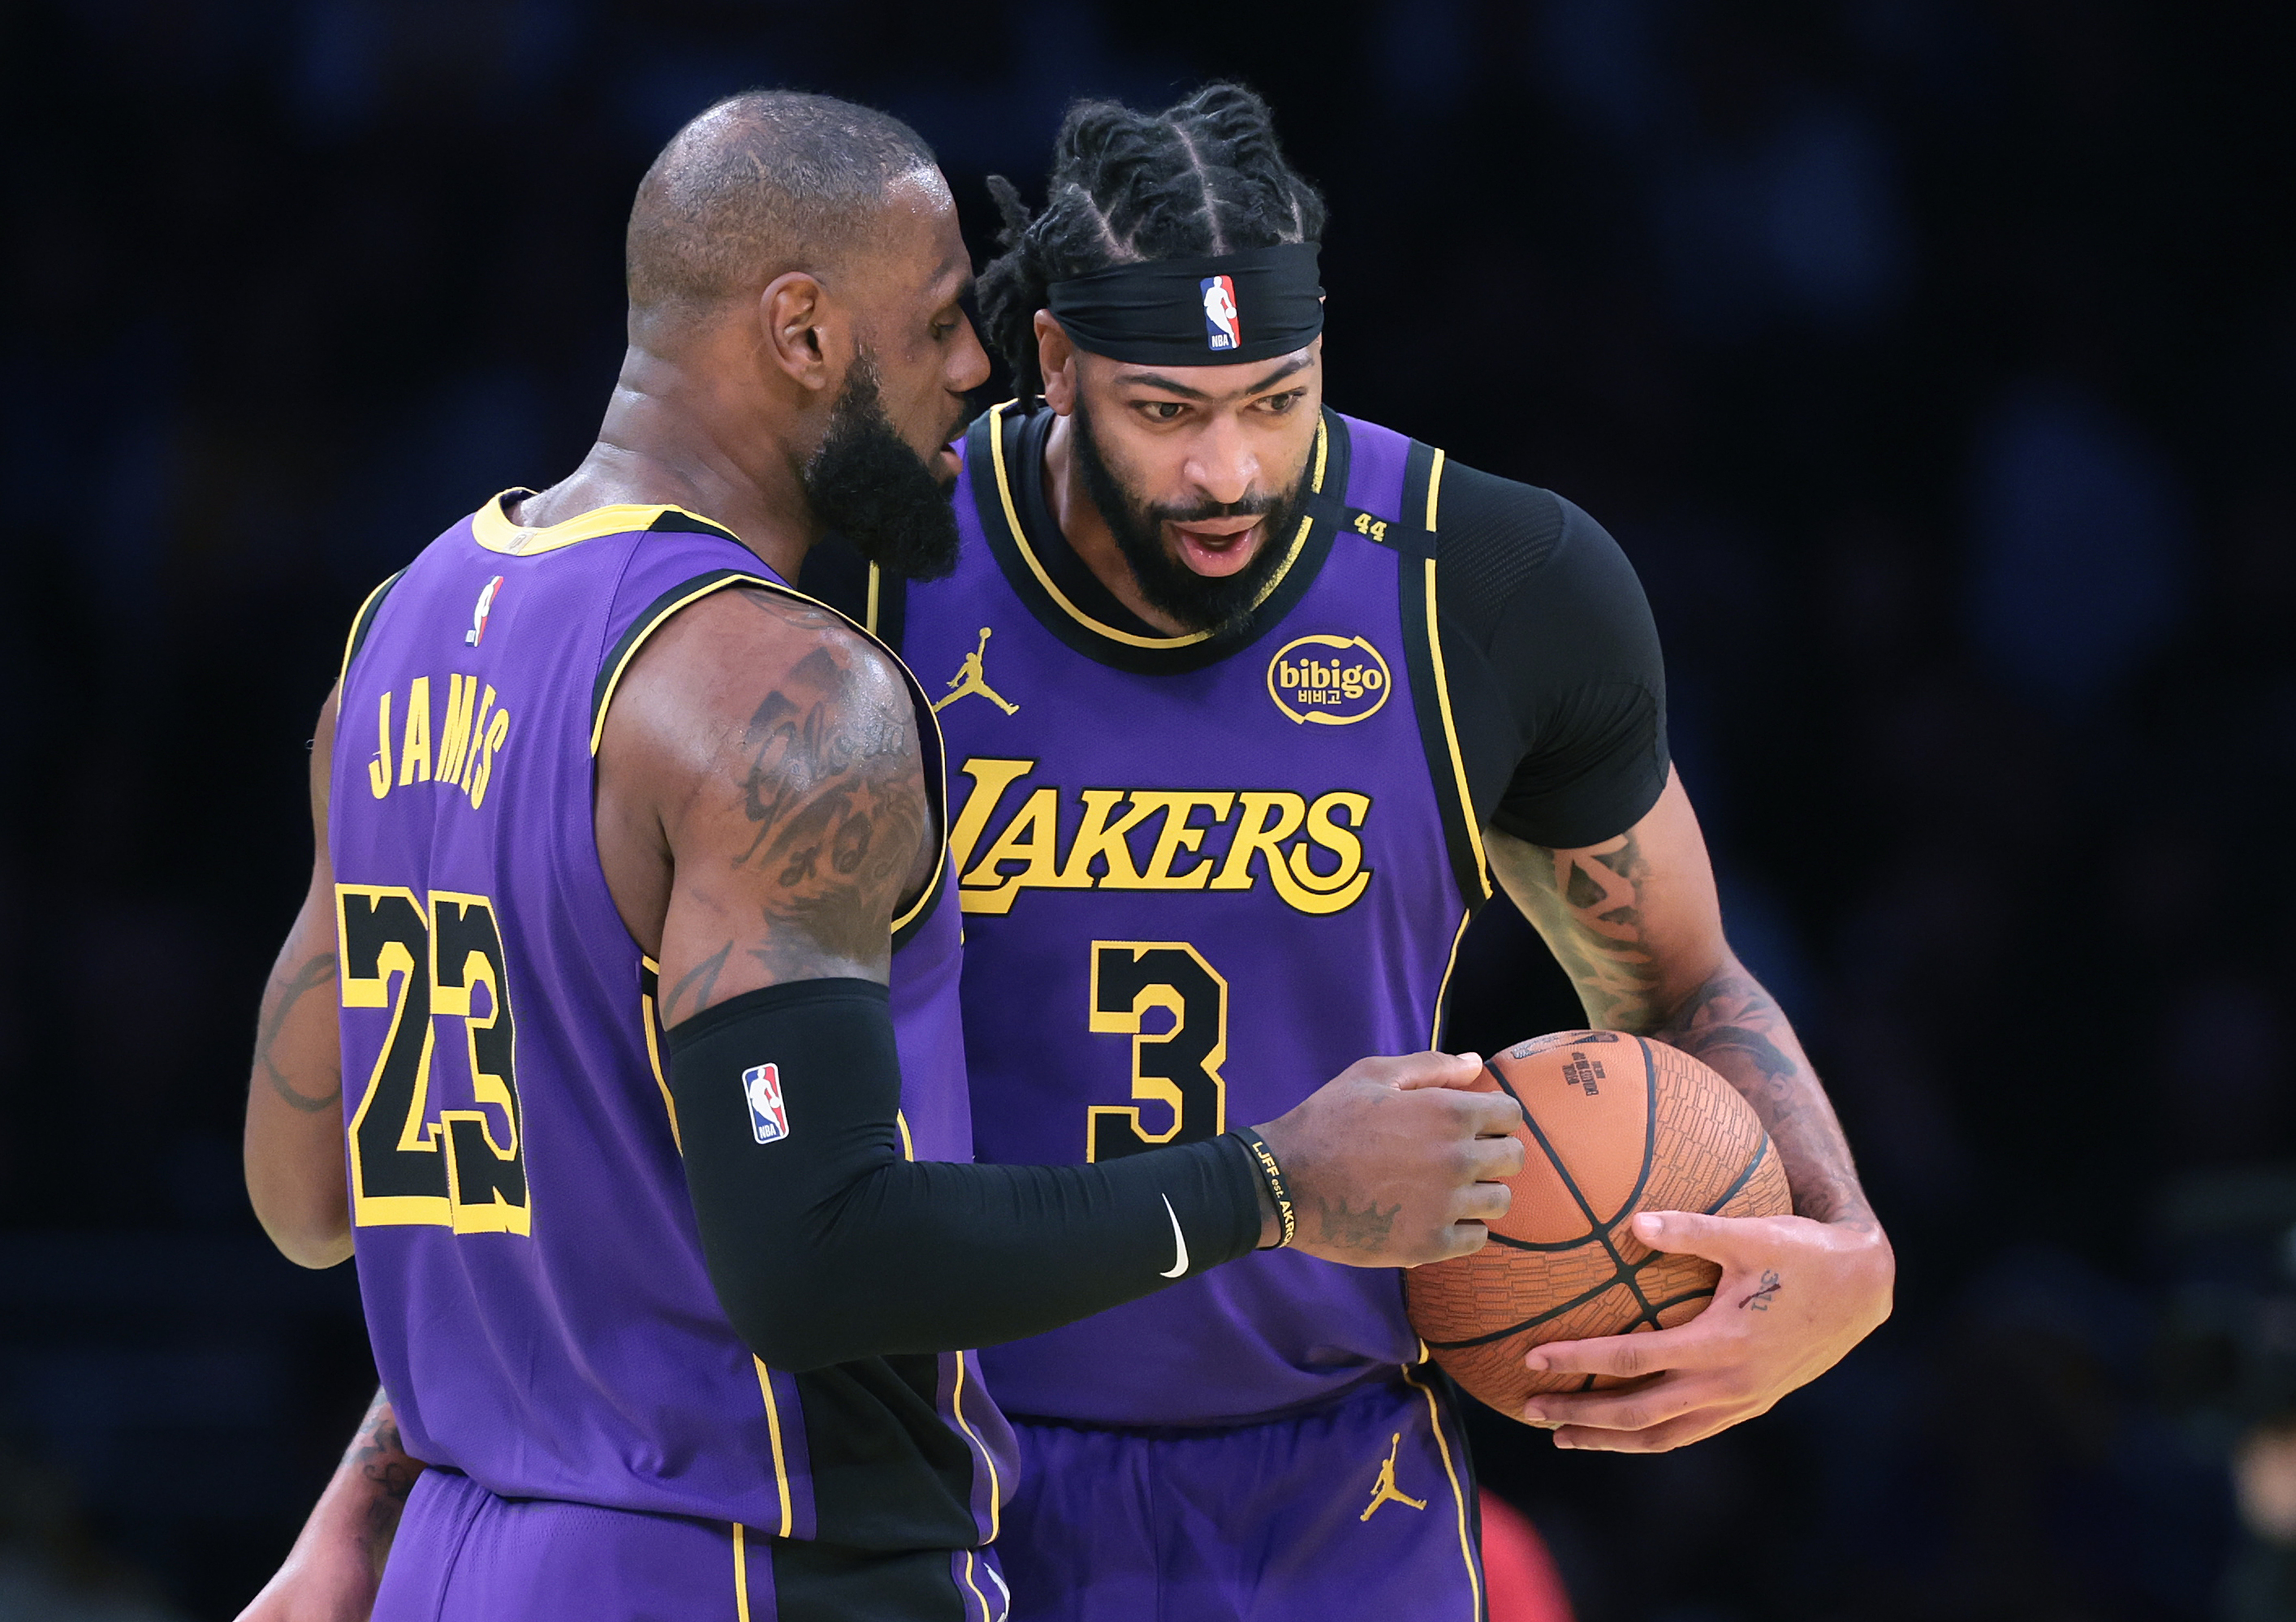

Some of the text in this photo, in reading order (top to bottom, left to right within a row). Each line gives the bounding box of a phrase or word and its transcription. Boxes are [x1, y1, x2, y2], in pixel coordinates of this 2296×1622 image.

[1211, 334, 1229, 347] NBA
[1353, 512, 1388, 542] 44
[1280, 658, 1383, 699] bibigo
[1297, 689, 1342, 705] 비비고
[368, 673, 510, 810] JAMES
[947, 757, 1375, 915] LAKERS
[334, 882, 531, 1237] 23
[1085, 939, 1229, 1164] 3
[758, 1123, 777, 1140] NBA
[1252, 1141, 1280, 1177] LJFF
